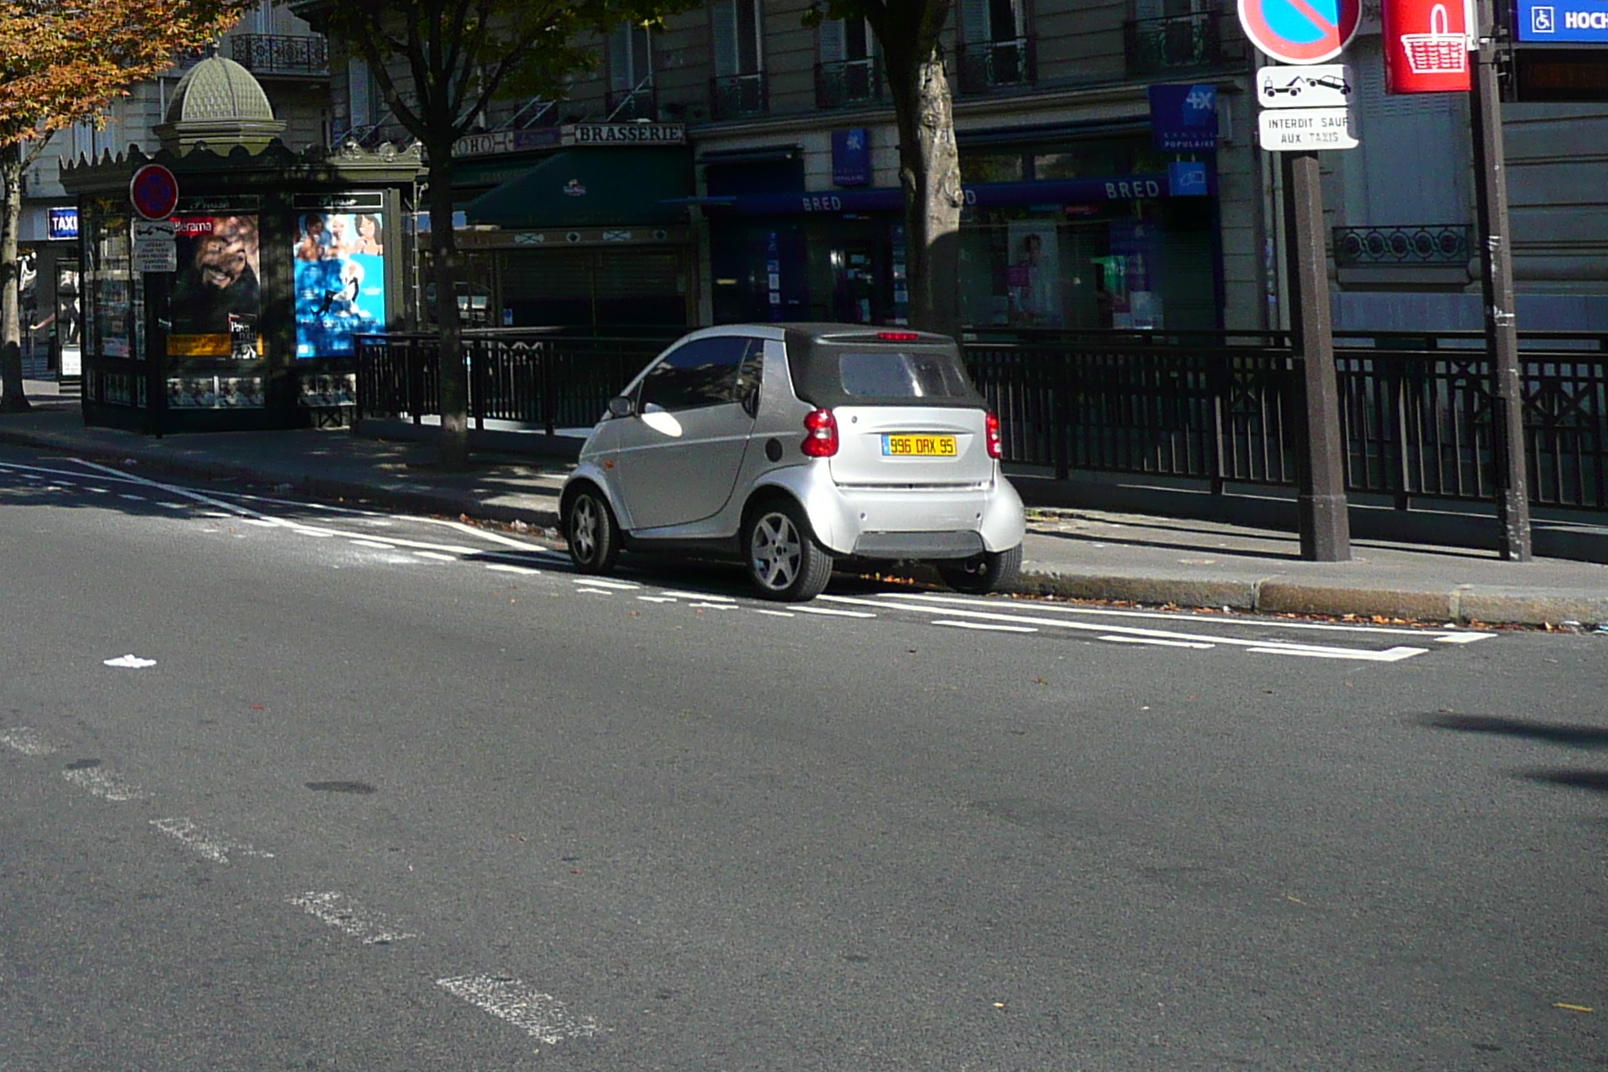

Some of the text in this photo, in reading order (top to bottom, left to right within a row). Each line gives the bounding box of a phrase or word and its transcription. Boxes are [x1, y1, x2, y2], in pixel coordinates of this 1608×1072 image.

[1564, 11, 1608, 29] HOCH
[1268, 116, 1349, 129] INTERDIT SAUF
[580, 125, 681, 143] BRASSERIE
[1281, 132, 1339, 143] AUX TAXIS
[1105, 180, 1160, 200] BRED
[802, 196, 842, 212] BRED
[52, 216, 79, 232] TAXI
[890, 439, 911, 454] 996
[940, 439, 954, 454] 95
